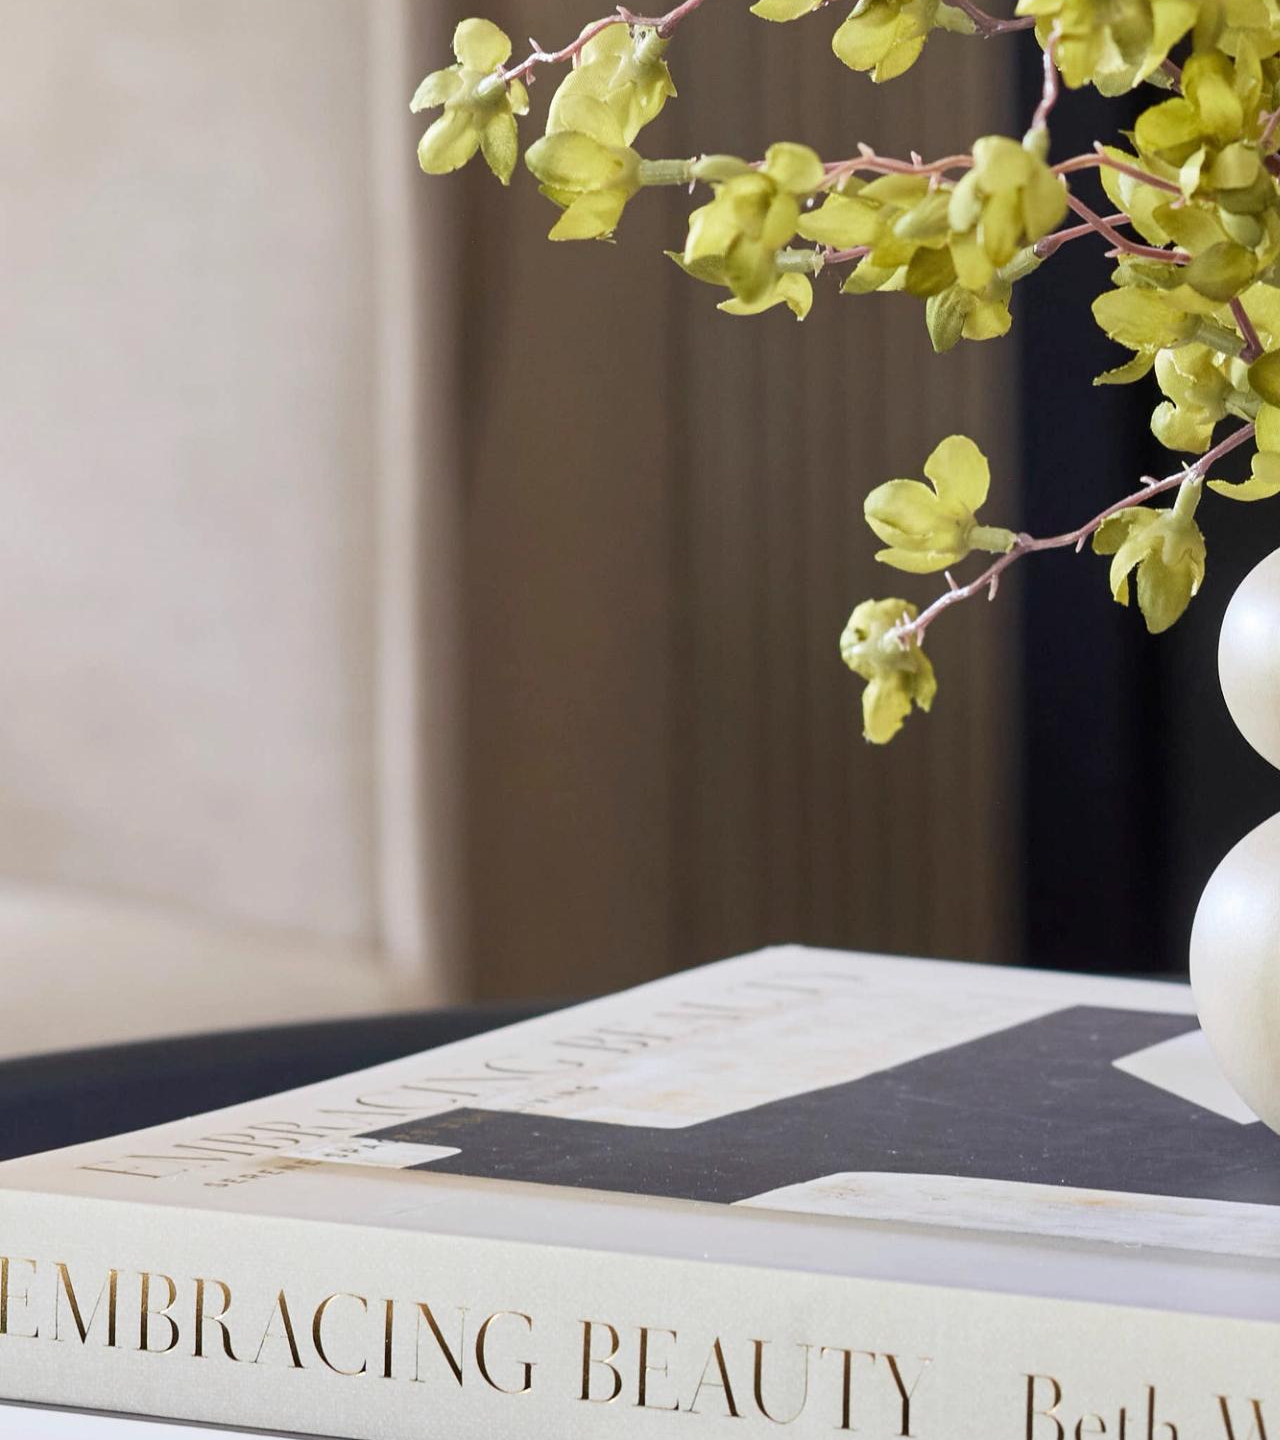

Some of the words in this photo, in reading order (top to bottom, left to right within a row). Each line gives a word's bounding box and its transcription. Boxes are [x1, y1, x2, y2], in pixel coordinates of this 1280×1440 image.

[78, 1054, 584, 1179] EMBRACING
[203, 1158, 322, 1188] SERENE
[0, 1256, 534, 1395] EMBRACING
[576, 1319, 934, 1438] BEAUTY
